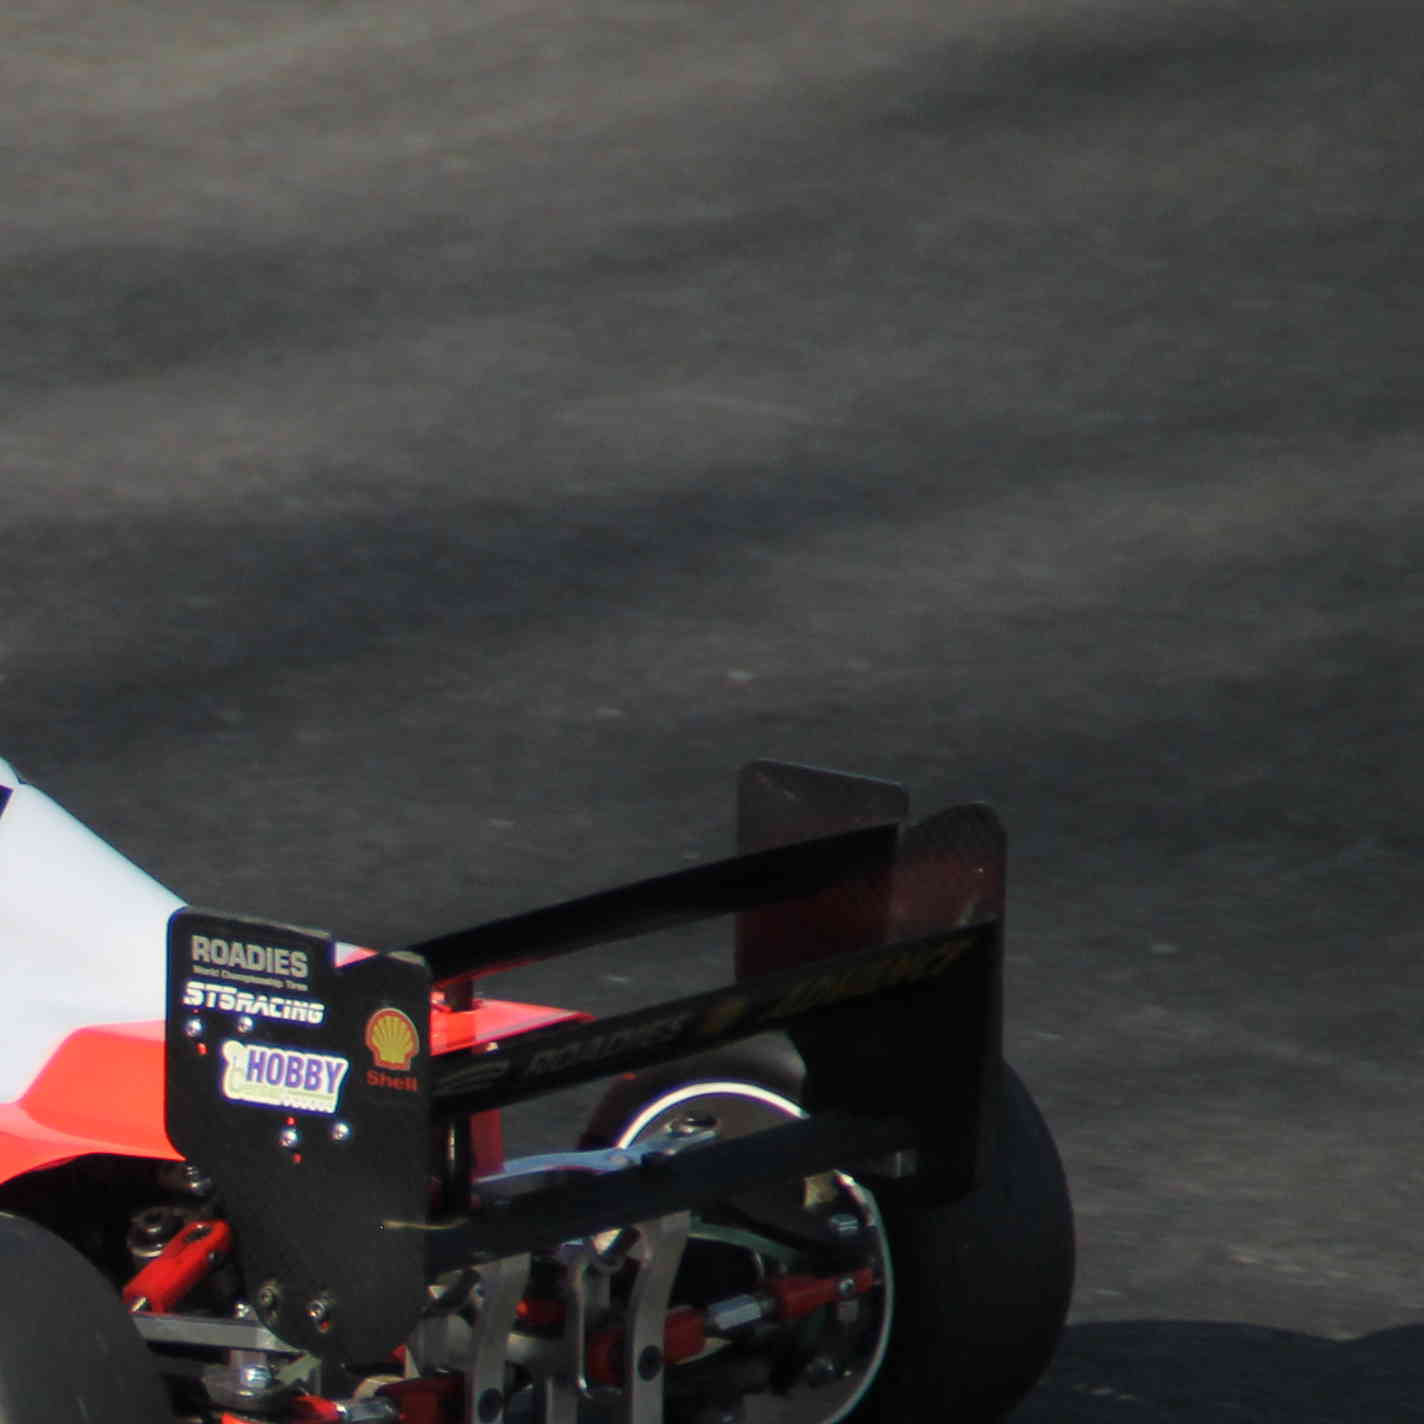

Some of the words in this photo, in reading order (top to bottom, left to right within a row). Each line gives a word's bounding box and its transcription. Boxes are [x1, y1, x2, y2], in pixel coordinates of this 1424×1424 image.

[191, 934, 309, 979] ROADIES
[244, 1049, 345, 1094] HOBBY
[365, 1069, 419, 1092] Shell
